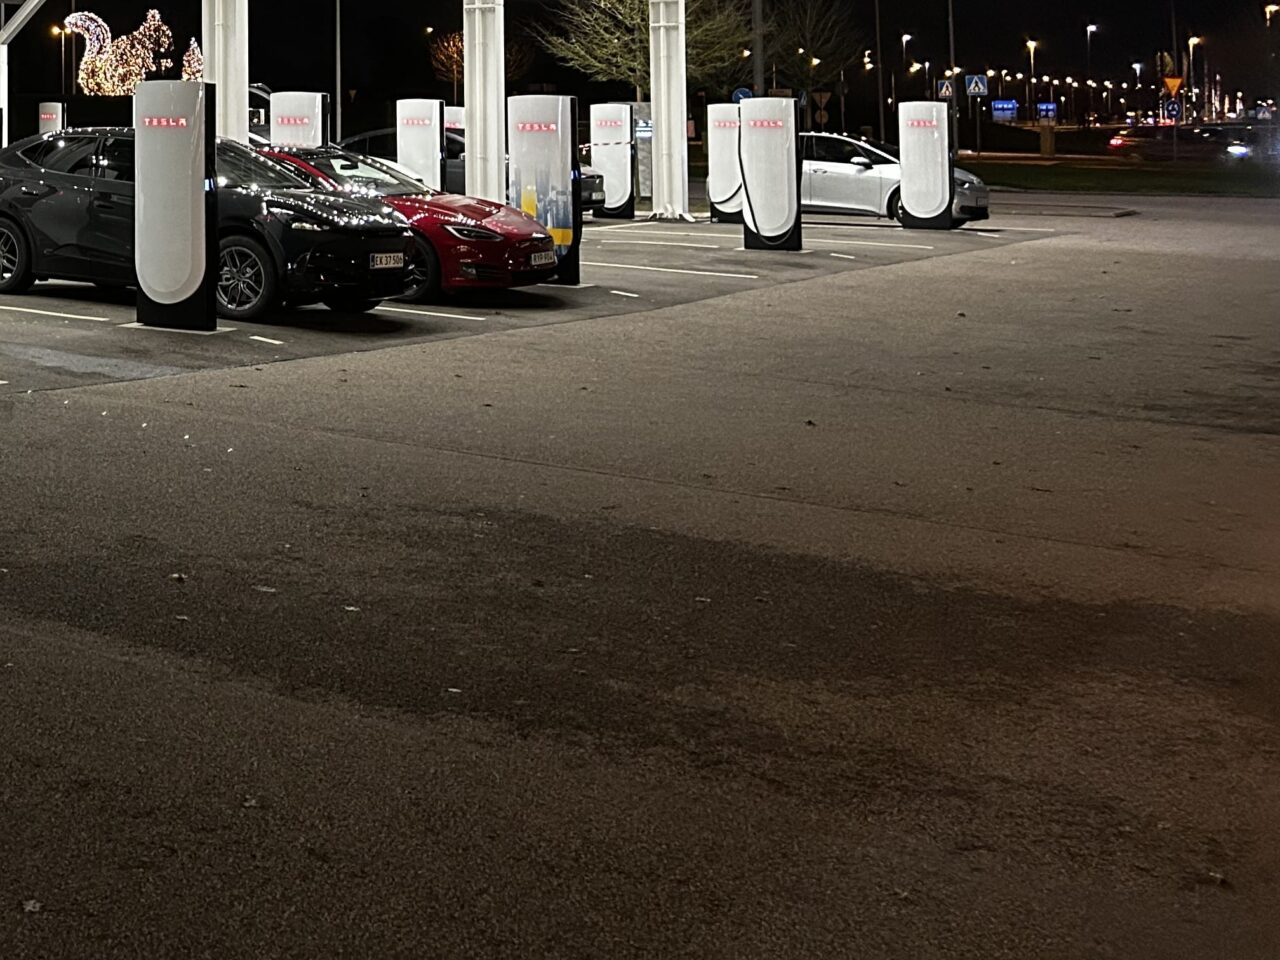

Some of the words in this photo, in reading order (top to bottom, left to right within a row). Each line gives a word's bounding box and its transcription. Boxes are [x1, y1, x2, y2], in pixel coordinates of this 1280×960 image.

[144, 117, 188, 126] TESLA
[277, 117, 310, 125] TESLA
[517, 122, 557, 132] TESLA
